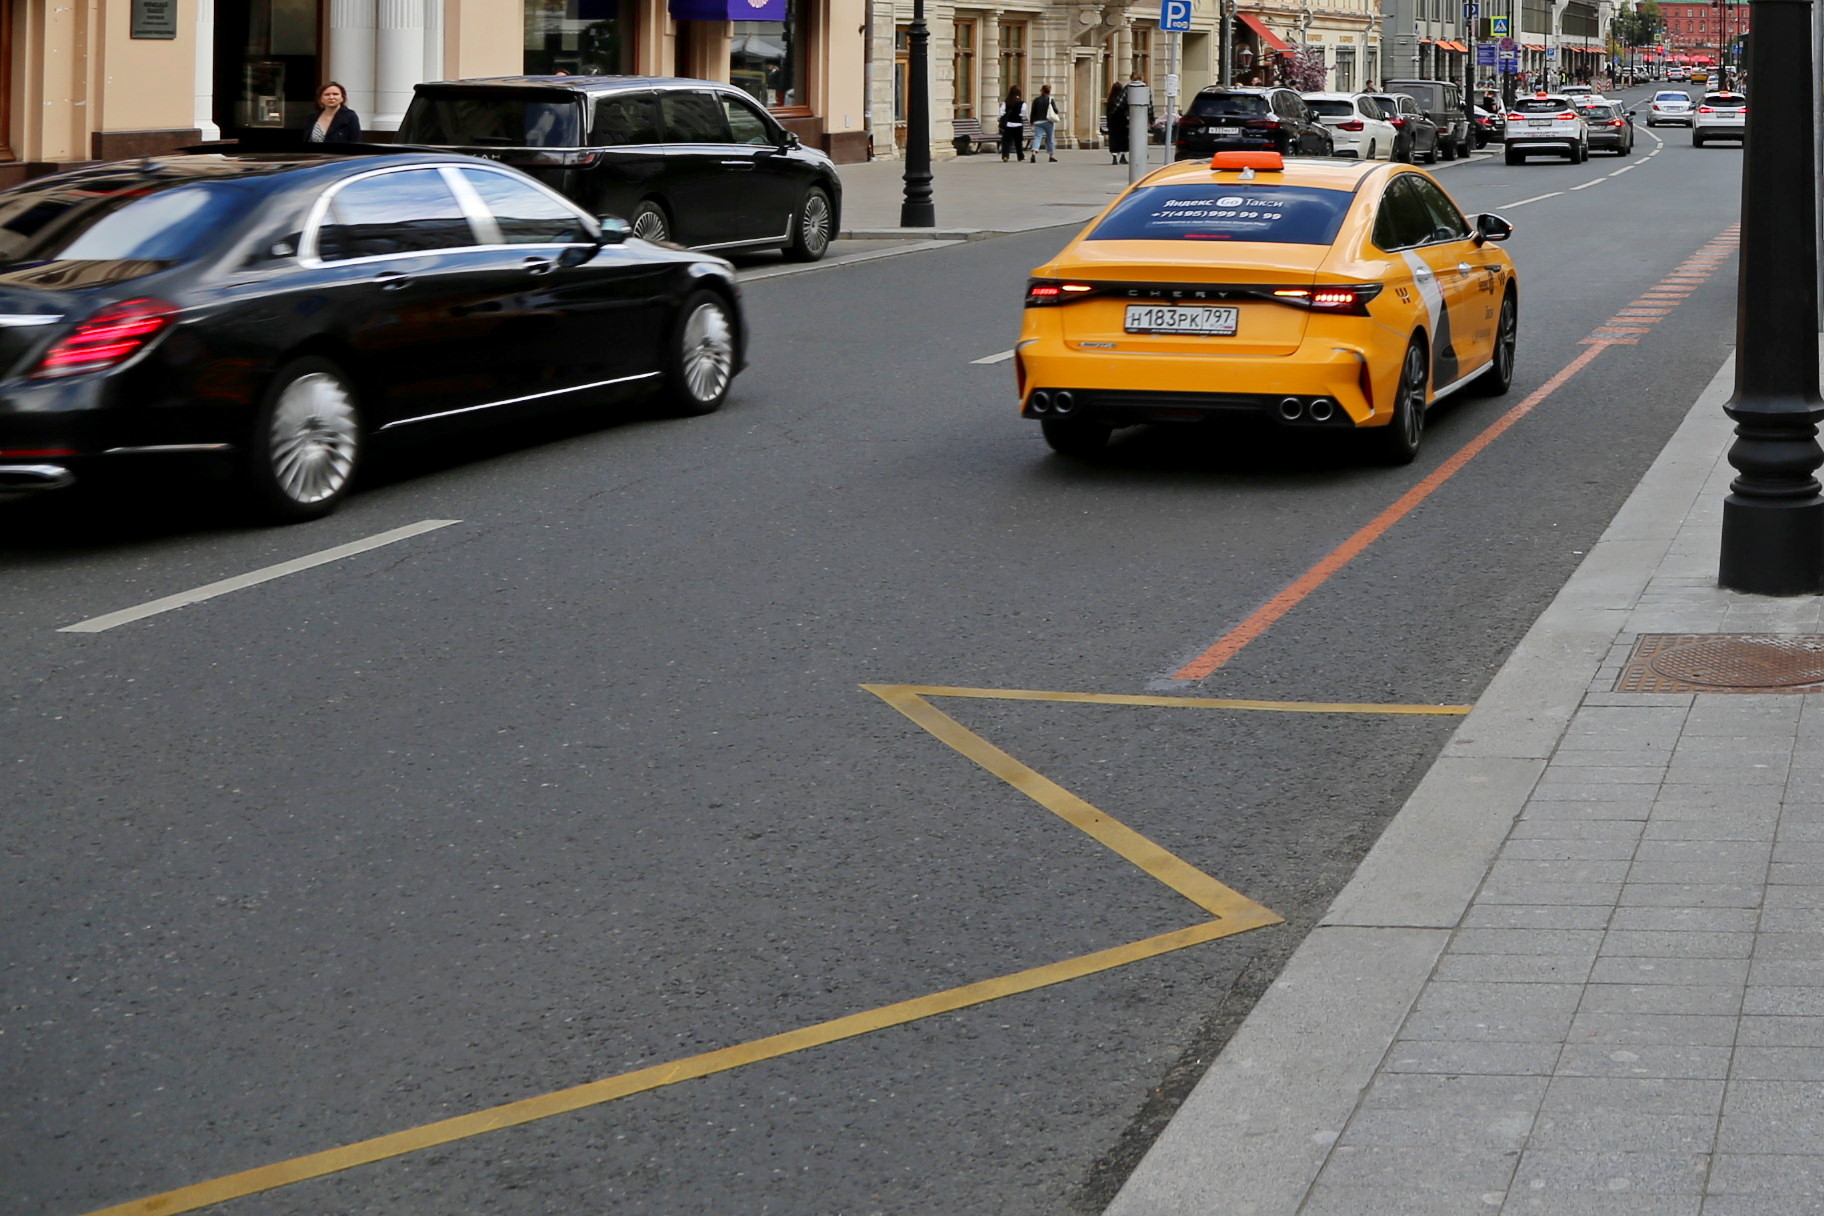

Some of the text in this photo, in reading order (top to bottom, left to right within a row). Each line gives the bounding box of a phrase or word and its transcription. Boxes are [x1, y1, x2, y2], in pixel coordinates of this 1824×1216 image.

[1166, 2, 1186, 28] P
[1163, 199, 1214, 208] Яндекс
[1246, 198, 1284, 207] Такси
[1128, 289, 1228, 298] CHERY
[1204, 309, 1232, 323] 797
